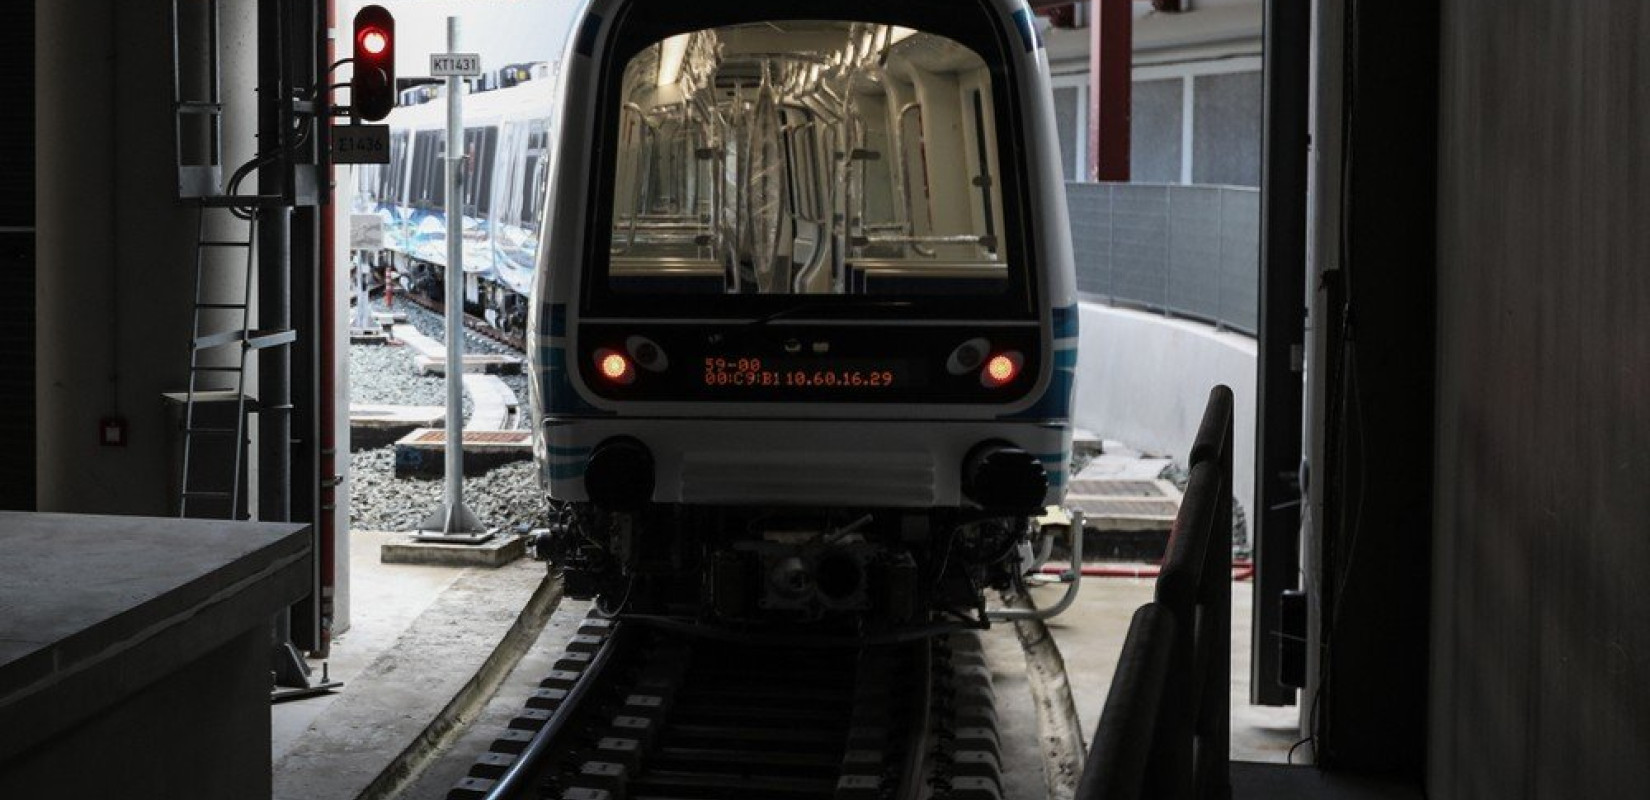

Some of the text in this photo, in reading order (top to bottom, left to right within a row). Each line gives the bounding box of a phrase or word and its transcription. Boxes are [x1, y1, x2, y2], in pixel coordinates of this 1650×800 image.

[433, 58, 476, 71] KT1431
[338, 137, 382, 152] Σ1436
[704, 357, 761, 372] 59-00
